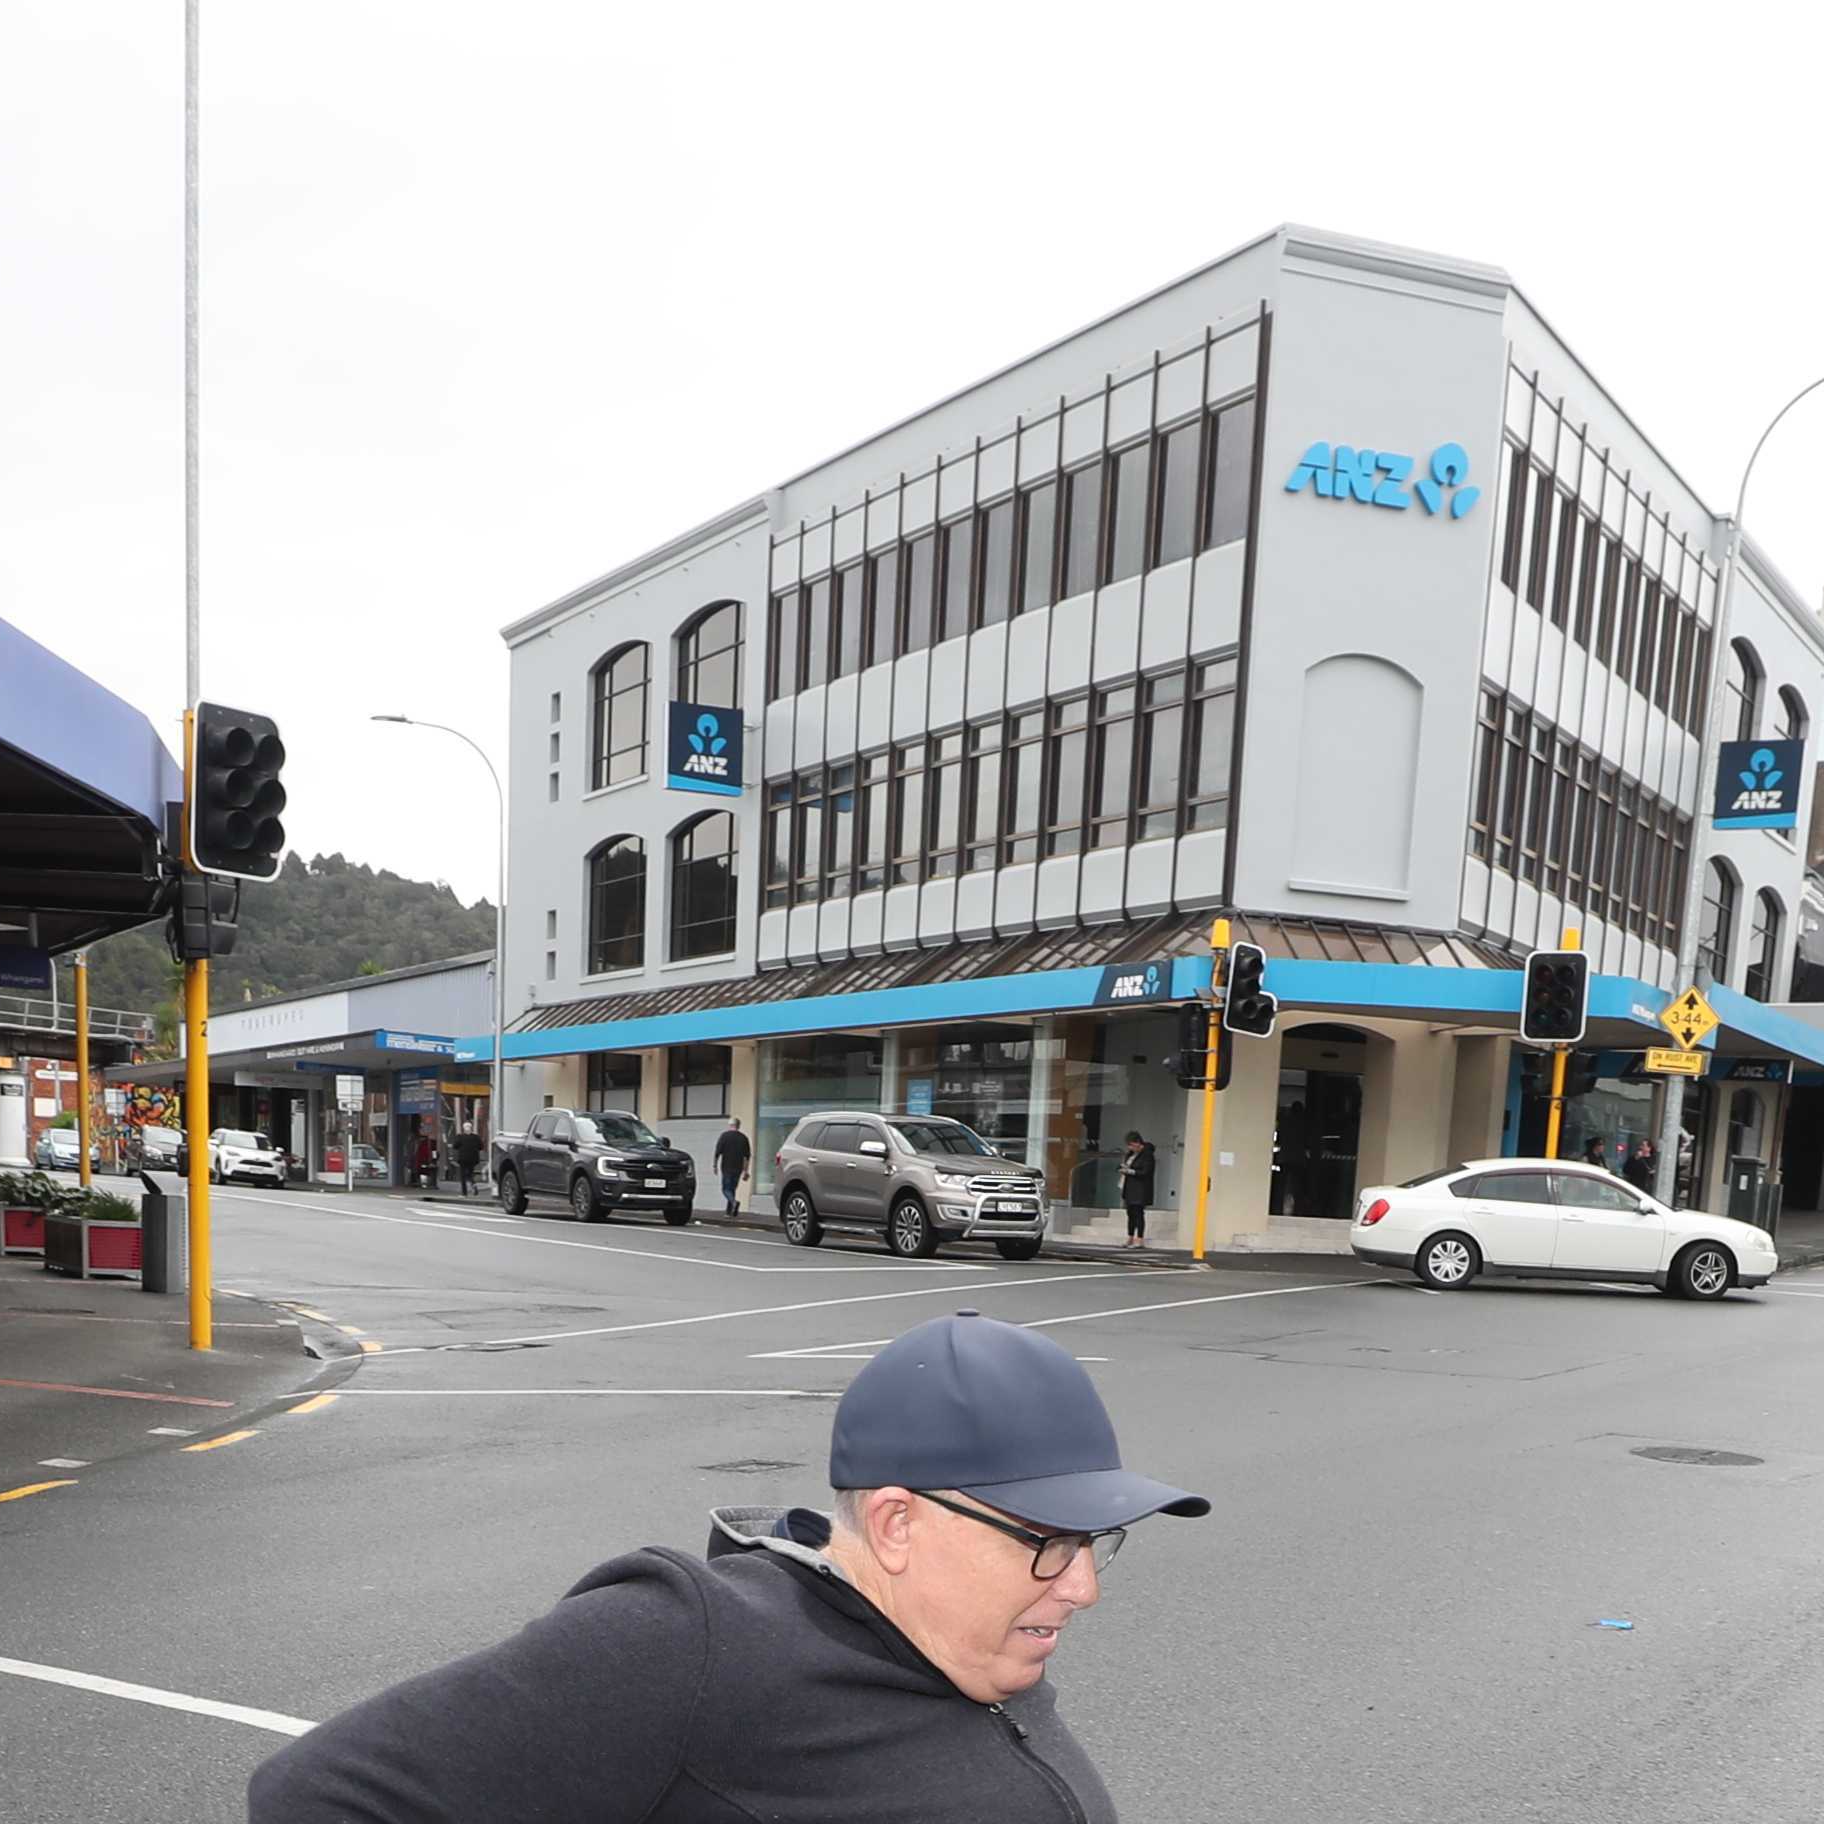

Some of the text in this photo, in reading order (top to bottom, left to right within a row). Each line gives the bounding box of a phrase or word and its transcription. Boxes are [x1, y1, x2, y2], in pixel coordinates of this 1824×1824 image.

[1284, 441, 1414, 510] ANZ
[682, 754, 729, 776] ANZ
[1731, 789, 1784, 810] ANZ
[1110, 974, 1145, 999] ANZ
